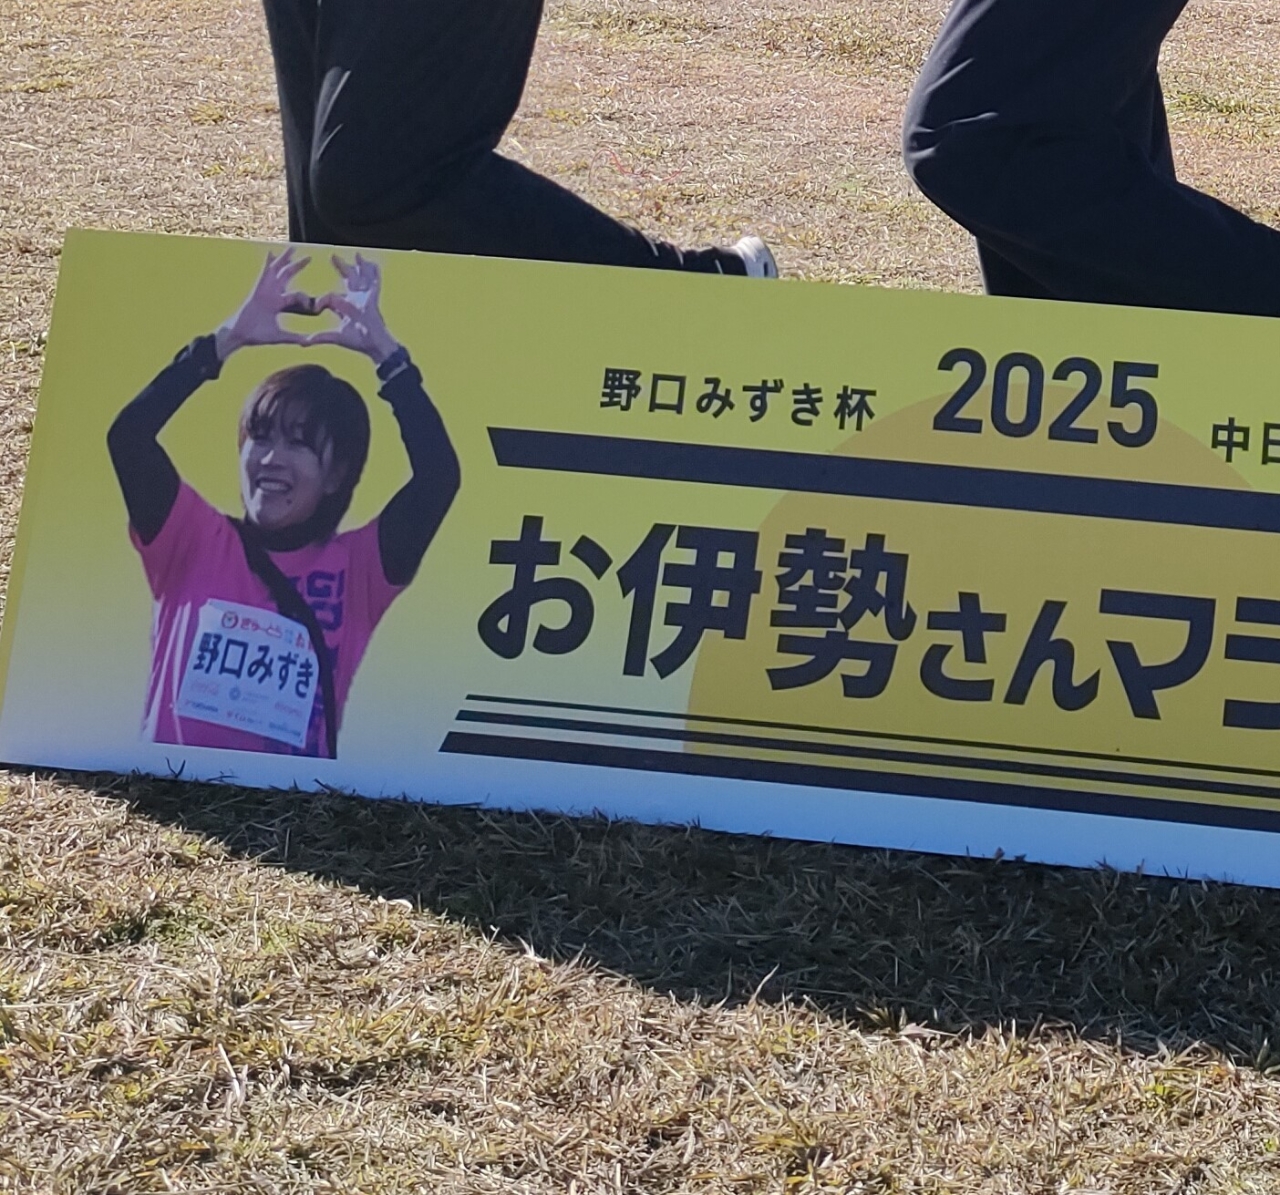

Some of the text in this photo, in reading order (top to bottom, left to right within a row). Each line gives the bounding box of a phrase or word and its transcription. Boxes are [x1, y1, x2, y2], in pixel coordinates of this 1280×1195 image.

[600, 367, 877, 432] 野口みずき杯
[932, 347, 1159, 447] 2025
[192, 632, 314, 699] 野口みずき
